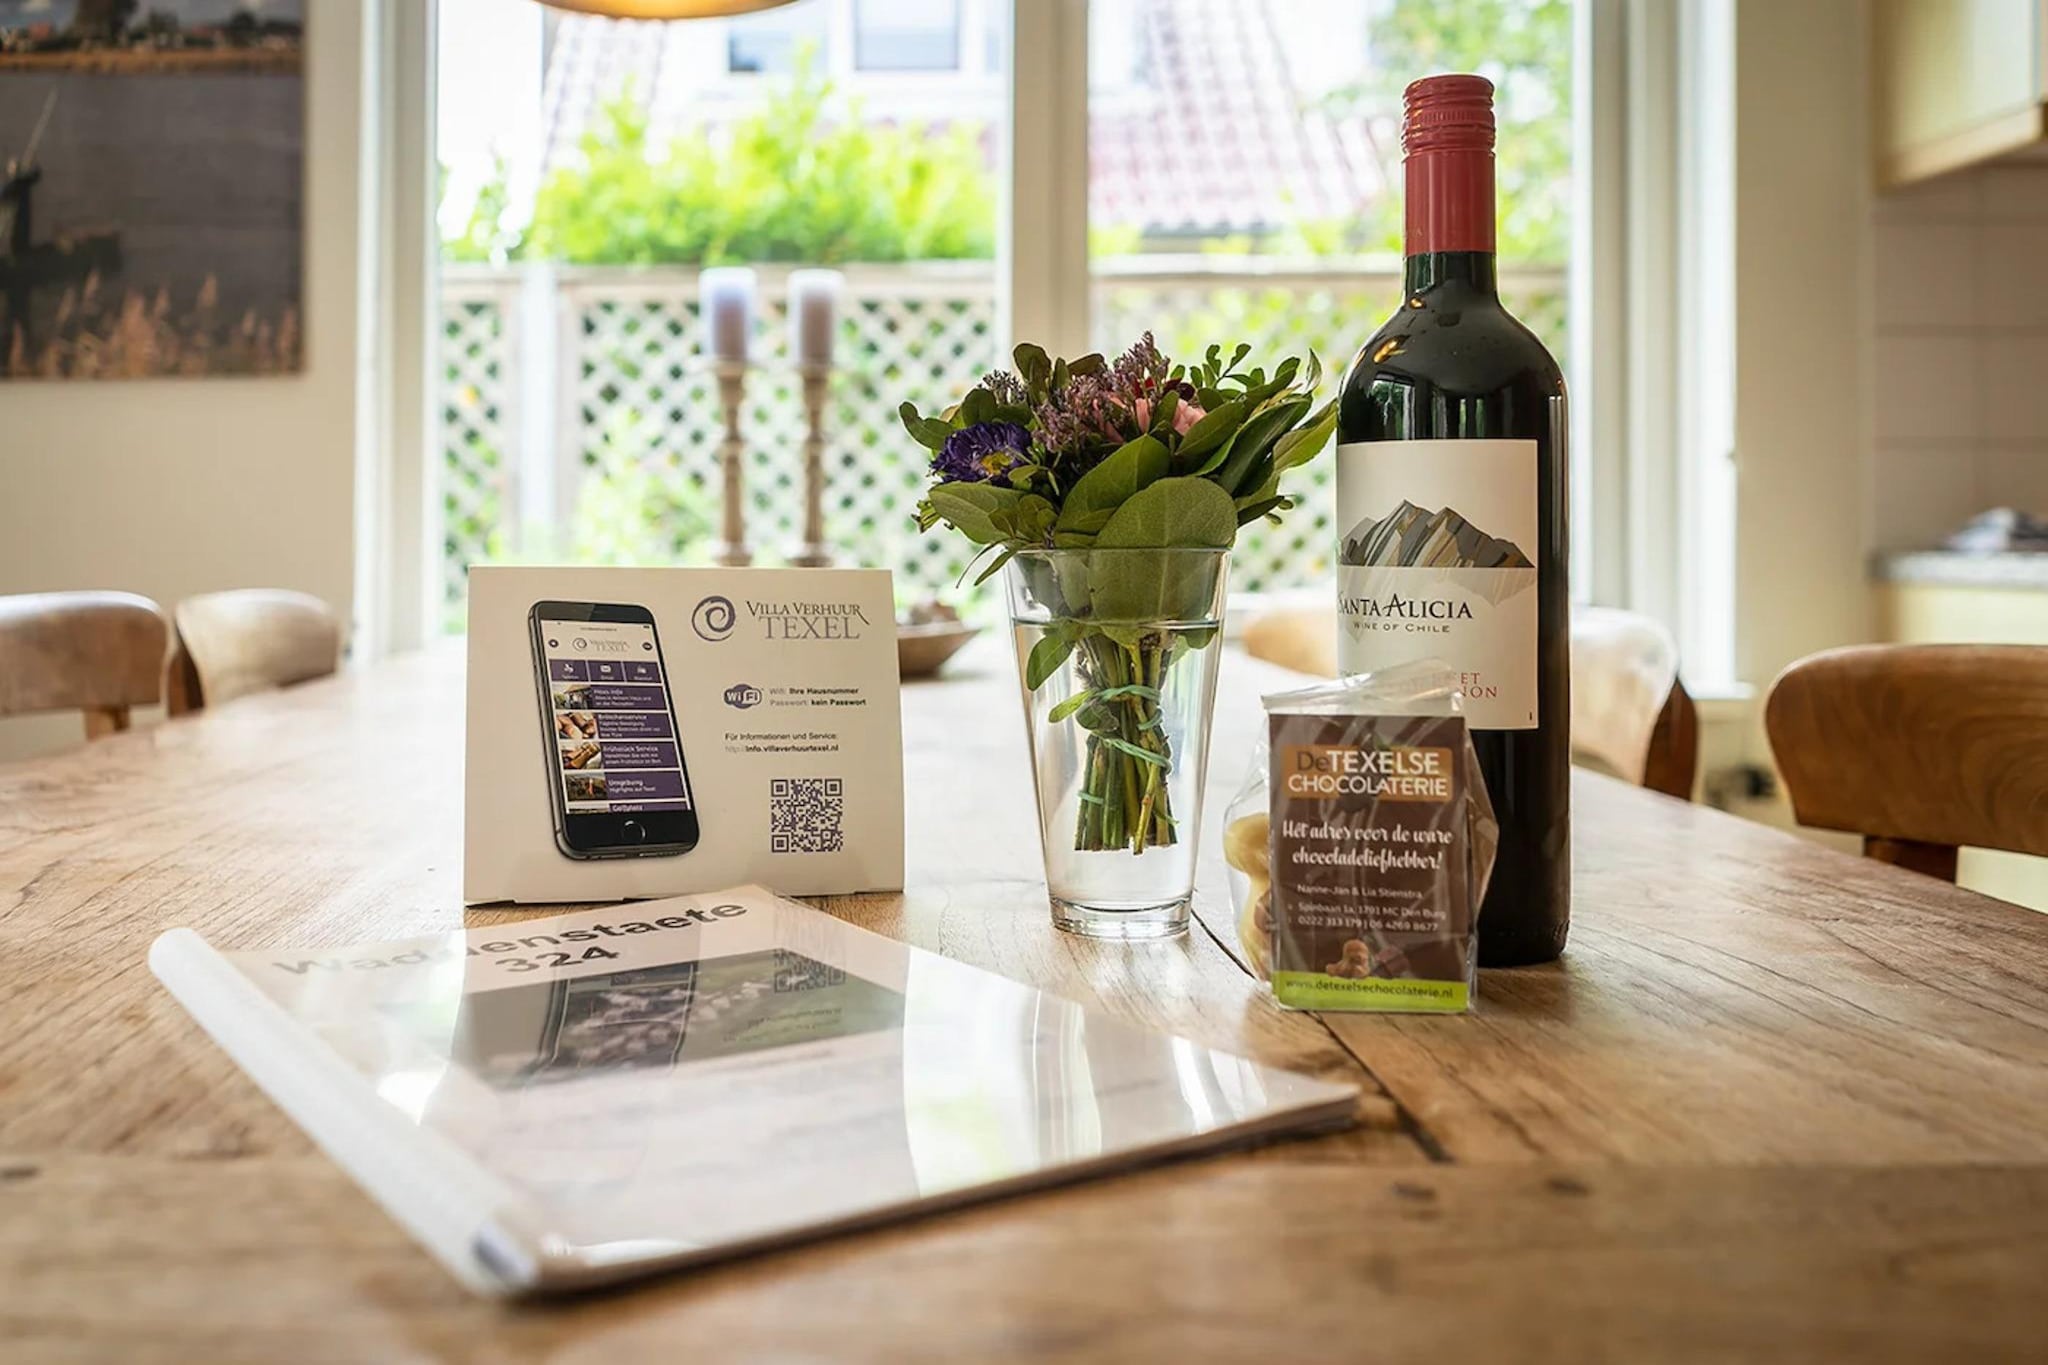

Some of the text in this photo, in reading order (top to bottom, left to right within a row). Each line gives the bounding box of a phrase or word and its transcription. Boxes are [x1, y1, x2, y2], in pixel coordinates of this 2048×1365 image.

[745, 600, 870, 625] VILLA VERHUUR
[1383, 593, 1473, 619] ALICIA
[758, 616, 860, 639] TEXEL
[1383, 623, 1399, 631] OF
[1405, 623, 1450, 632] CHILE
[1288, 774, 1448, 796] CHOCOLATERIE
[1310, 821, 1351, 840] adres
[1354, 826, 1388, 842] voor
[1392, 824, 1411, 843] de
[1413, 829, 1453, 844] ware
[1292, 846, 1442, 874] chocoladeliefhebber!
[1362, 887, 1376, 897] Lia
[272, 904, 748, 975] Wadenstaete
[496, 945, 621, 973] 324
[1286, 979, 1453, 998] www.detexelsechocolaterie.nl
